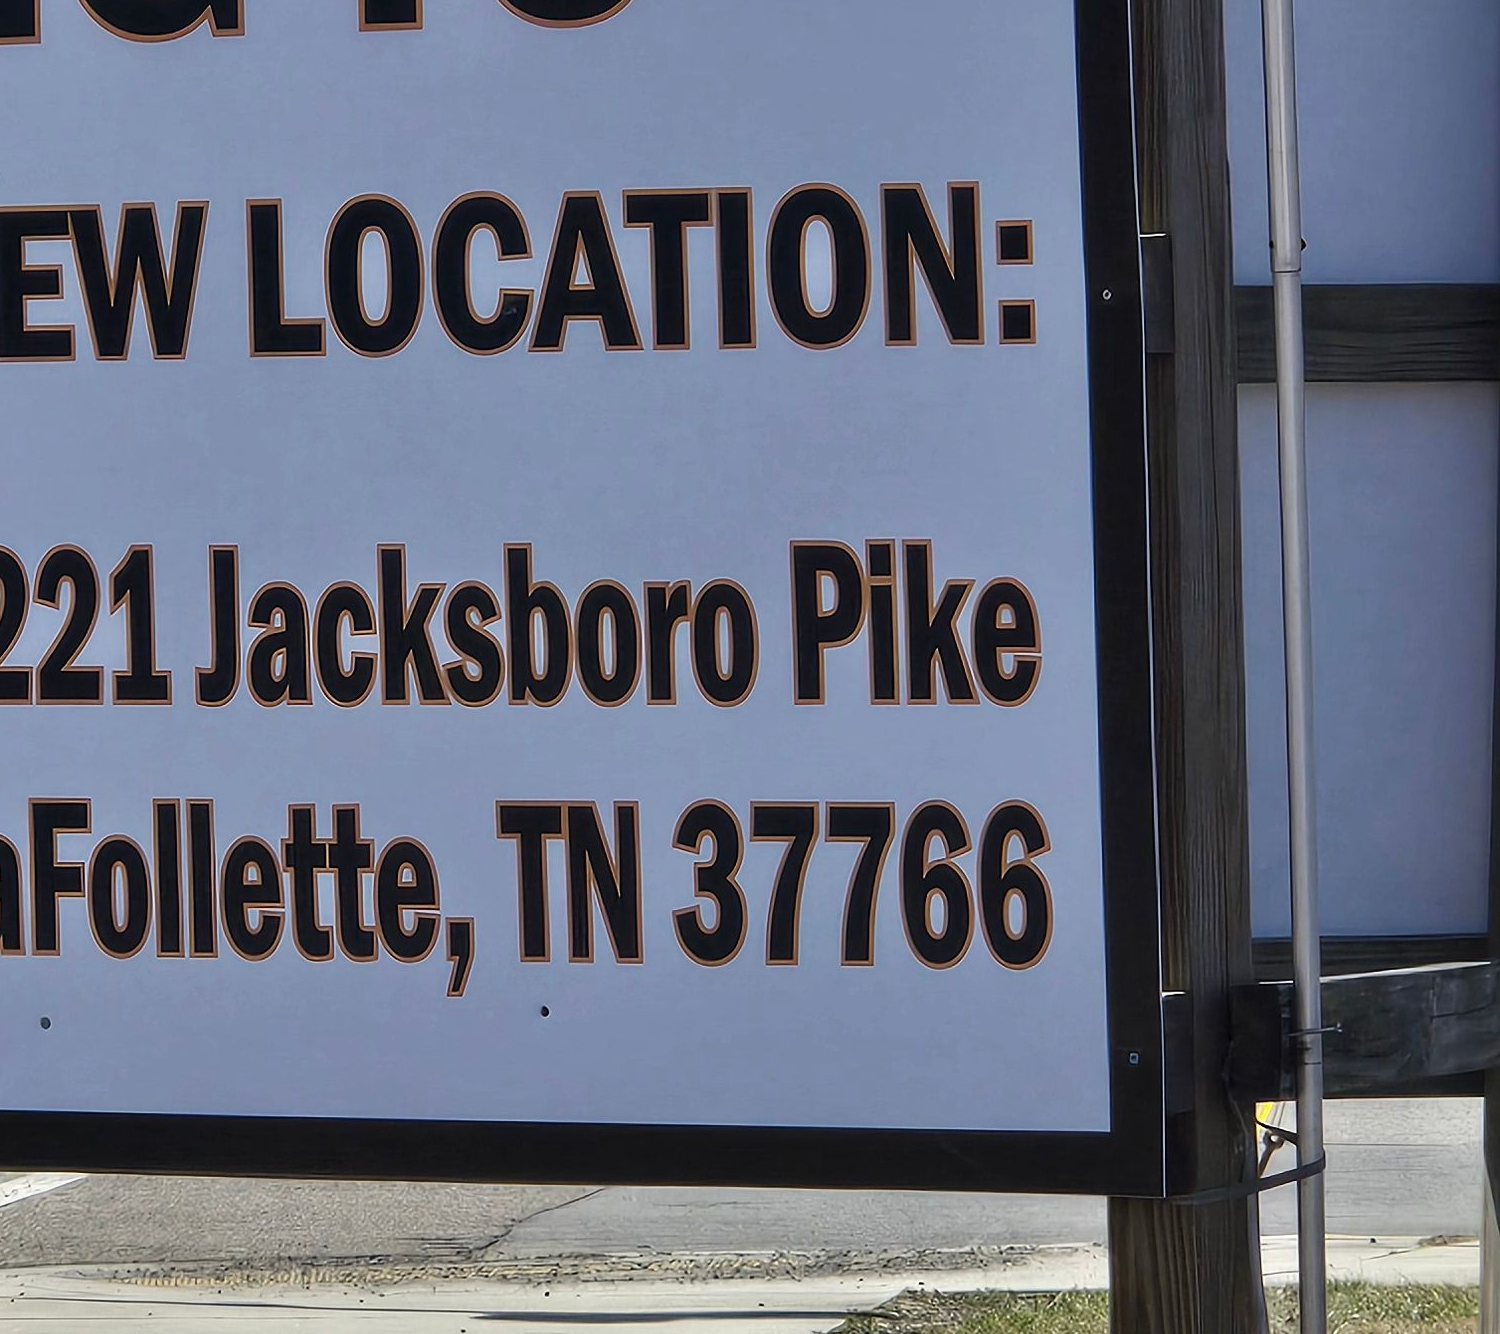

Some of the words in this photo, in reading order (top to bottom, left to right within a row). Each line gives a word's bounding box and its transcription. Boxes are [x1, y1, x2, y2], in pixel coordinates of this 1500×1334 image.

[245, 180, 1037, 359] LOCATION:
[194, 542, 759, 708] Jacksboro
[789, 538, 1043, 706] Pike
[496, 800, 644, 965] TN
[673, 799, 1053, 970] 37766
